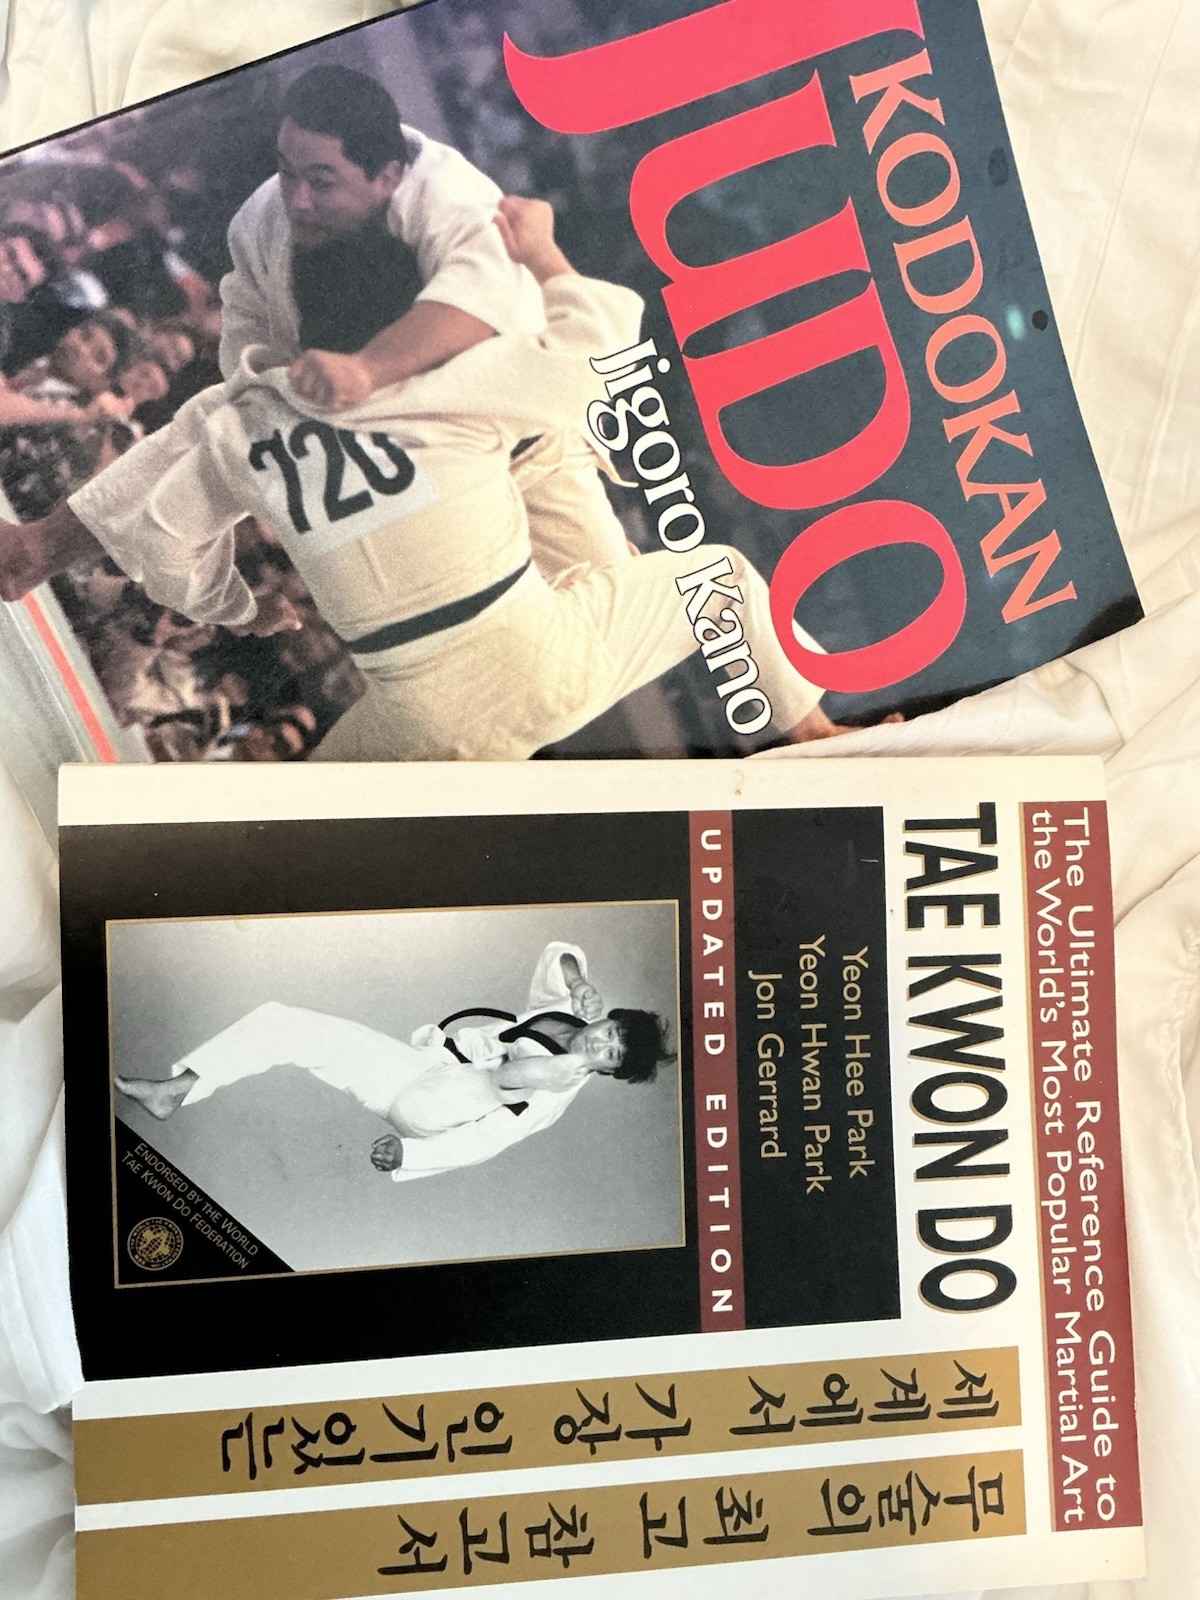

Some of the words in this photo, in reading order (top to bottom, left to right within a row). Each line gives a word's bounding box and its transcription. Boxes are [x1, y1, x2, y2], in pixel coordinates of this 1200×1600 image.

[502, 0, 968, 693] JUDO
[849, 48, 1078, 625] KODOKAN
[586, 337, 707, 554] Jigoro
[675, 555, 773, 736] Kano
[903, 802, 1000, 929] TAE
[1031, 809, 1058, 869] the
[1064, 806, 1090, 887] The
[701, 829, 726, 1056] UPDATED
[799, 934, 826, 1010] Yeon
[842, 946, 869, 1021] Yeon
[1035, 877, 1066, 1023] World's
[748, 970, 783, 1021] Jon
[1067, 904, 1096, 1082] Ultimate
[757, 1033, 788, 1159] Gerrard
[801, 1023, 828, 1111] Hwan
[845, 1034, 872, 1096] Hee
[905, 953, 1010, 1181] KWON
[1041, 1040, 1068, 1136] Most
[803, 1124, 833, 1194] Park
[846, 1108, 876, 1178] Park
[121, 1151, 143, 1174] TAE
[140, 1169, 175, 1202] KWON
[172, 1197, 191, 1217] DO
[189, 1212, 250, 1270] FEDERATION
[133, 1142, 189, 1193] ENDORSED
[186, 1190, 203, 1205] BY
[201, 1202, 223, 1224] THE
[221, 1217, 259, 1257] WORLD
[706, 1094, 734, 1313] EDITION
[1040, 1150, 1078, 1296] Popular
[1075, 1100, 1106, 1312] Reference
[915, 1203, 1017, 1315] DO
[553, 1382, 692, 1456] 가장
[729, 1359, 1000, 1435] 세계에서
[1054, 1311, 1086, 1443] Martial
[1088, 1329, 1119, 1458] Guide
[220, 1400, 513, 1481] 인기있는
[639, 1485, 770, 1559] 최고
[806, 1465, 1005, 1537] 무술의
[1061, 1454, 1088, 1525] Art
[1096, 1473, 1117, 1522] to
[377, 1501, 596, 1577] 참고서
